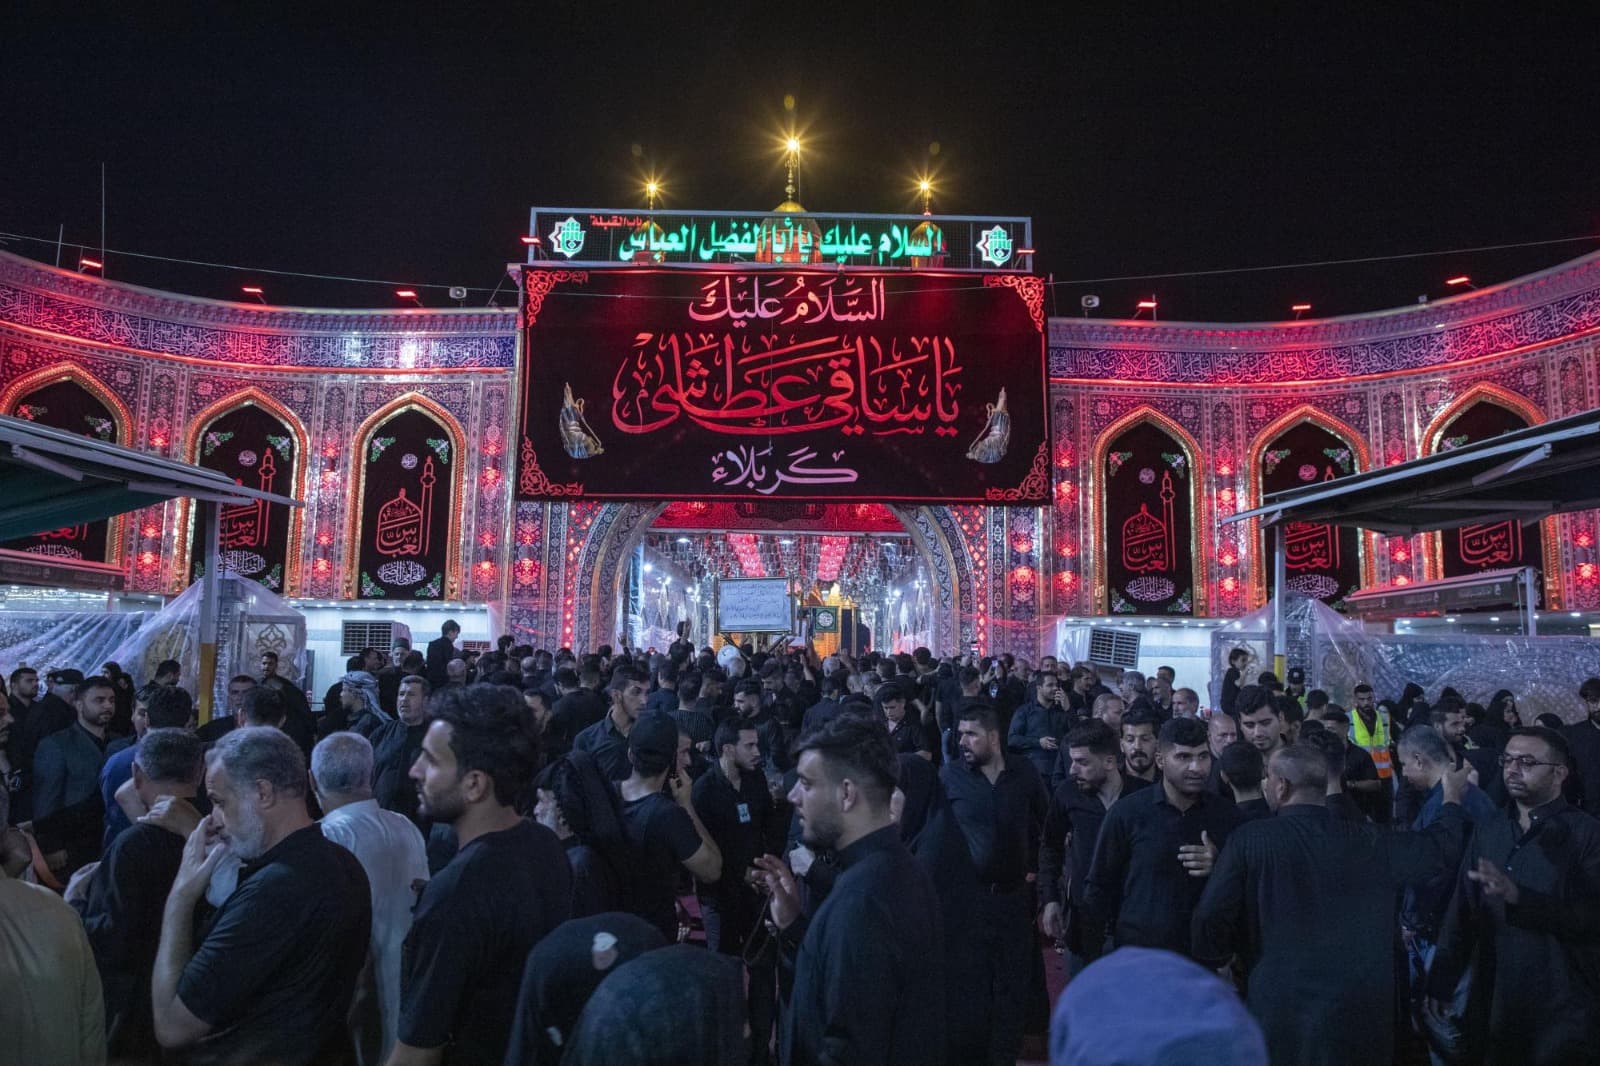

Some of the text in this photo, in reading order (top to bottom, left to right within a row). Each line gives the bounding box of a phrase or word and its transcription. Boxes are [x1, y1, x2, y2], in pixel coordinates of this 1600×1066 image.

[590, 215, 626, 230] القبلة
[619, 222, 696, 263] العباس
[700, 220, 768, 261] الفضل
[798, 224, 814, 263] يا
[820, 223, 873, 264] عليك
[879, 223, 942, 265] السلام
